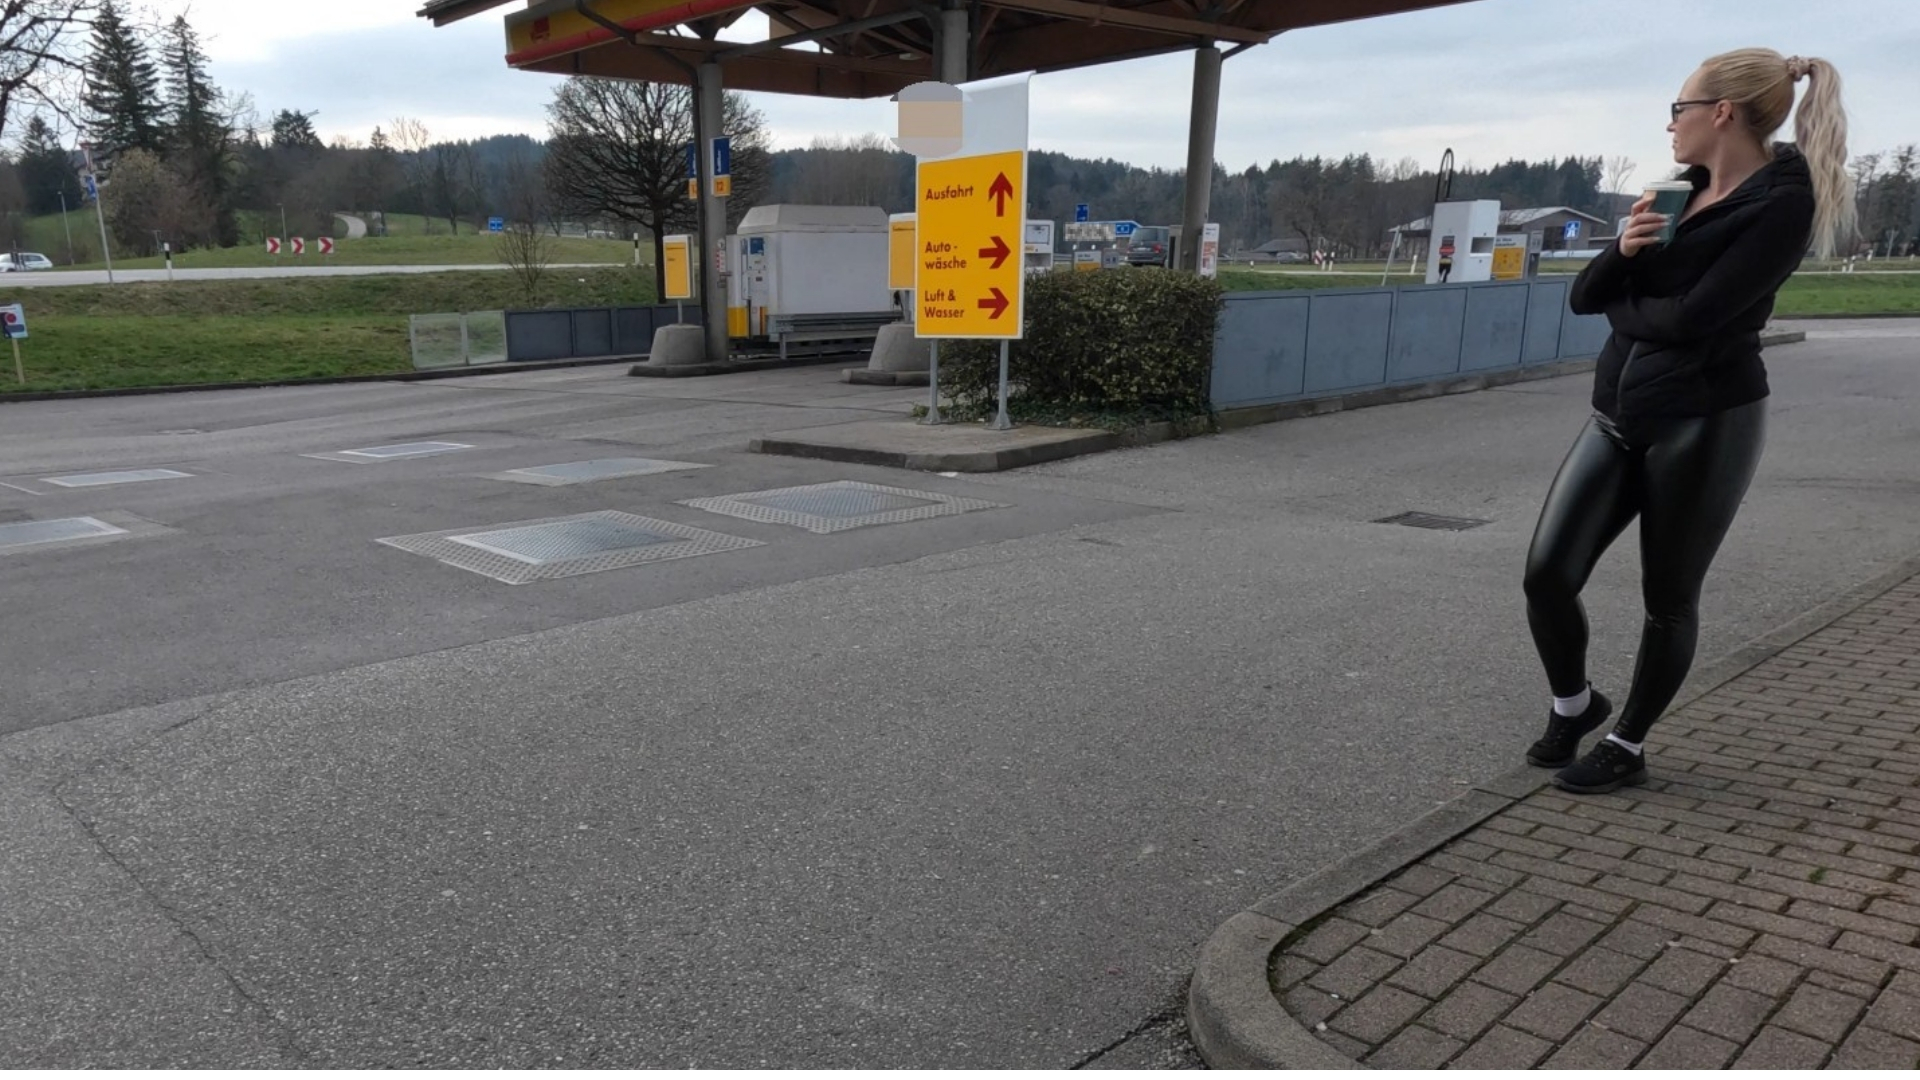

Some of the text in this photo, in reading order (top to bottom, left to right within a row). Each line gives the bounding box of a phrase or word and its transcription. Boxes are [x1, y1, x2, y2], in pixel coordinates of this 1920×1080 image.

[925, 184, 974, 200] Ausfahrt
[925, 255, 967, 269] wäsche
[925, 289, 956, 302] Luft &
[924, 306, 965, 318] Wasser
